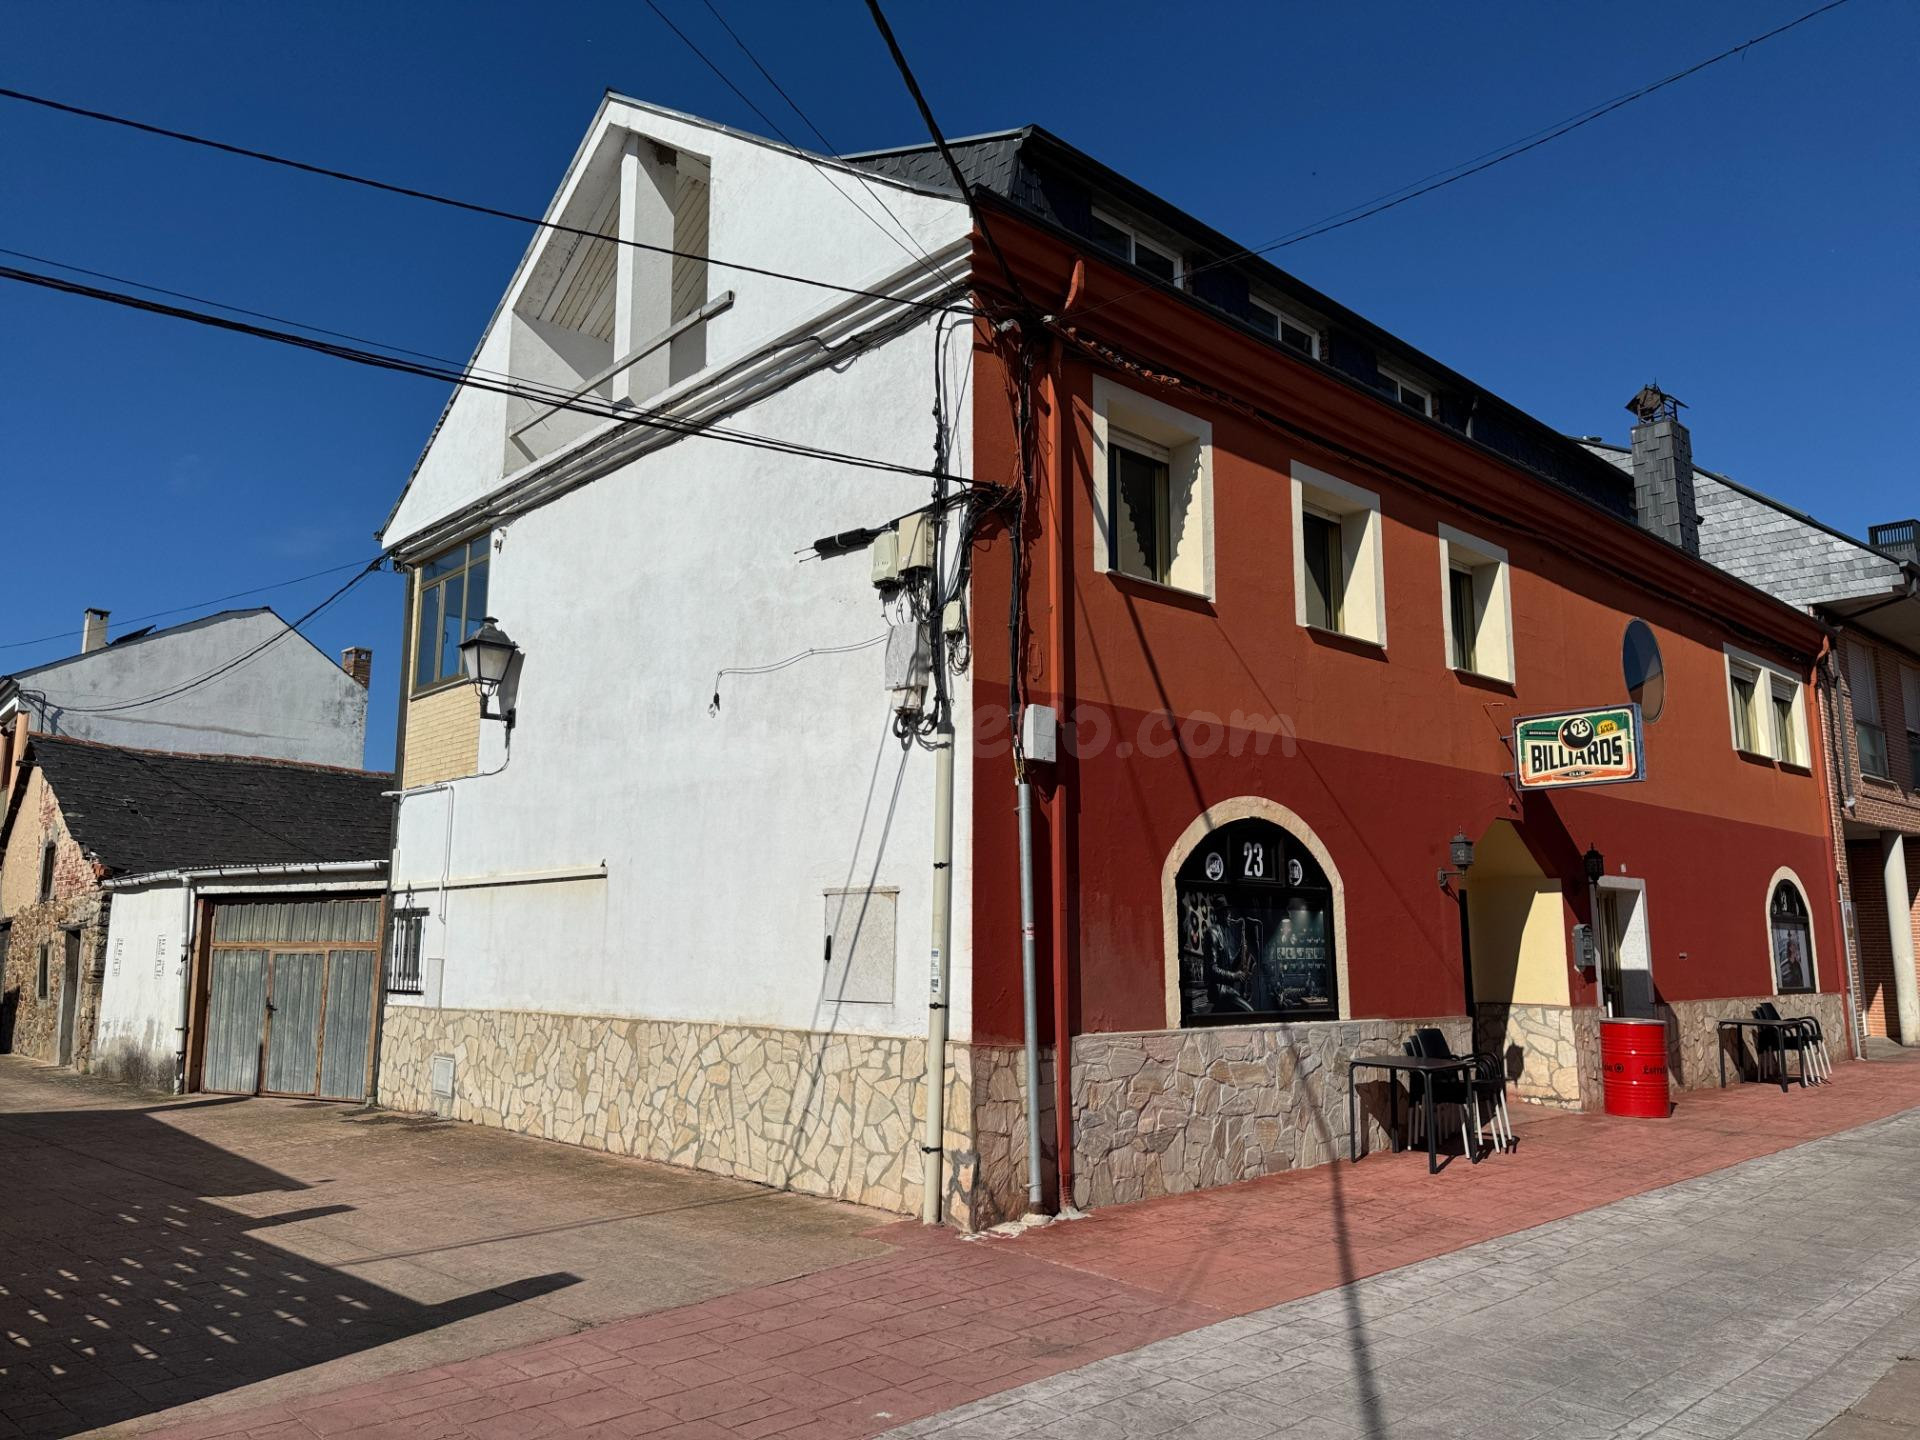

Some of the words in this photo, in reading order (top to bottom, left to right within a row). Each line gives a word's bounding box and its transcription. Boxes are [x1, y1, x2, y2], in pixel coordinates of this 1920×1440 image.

[1572, 721, 1588, 735] 23
[1532, 736, 1623, 773] BILLIARDS
[1243, 842, 1263, 876] 23
